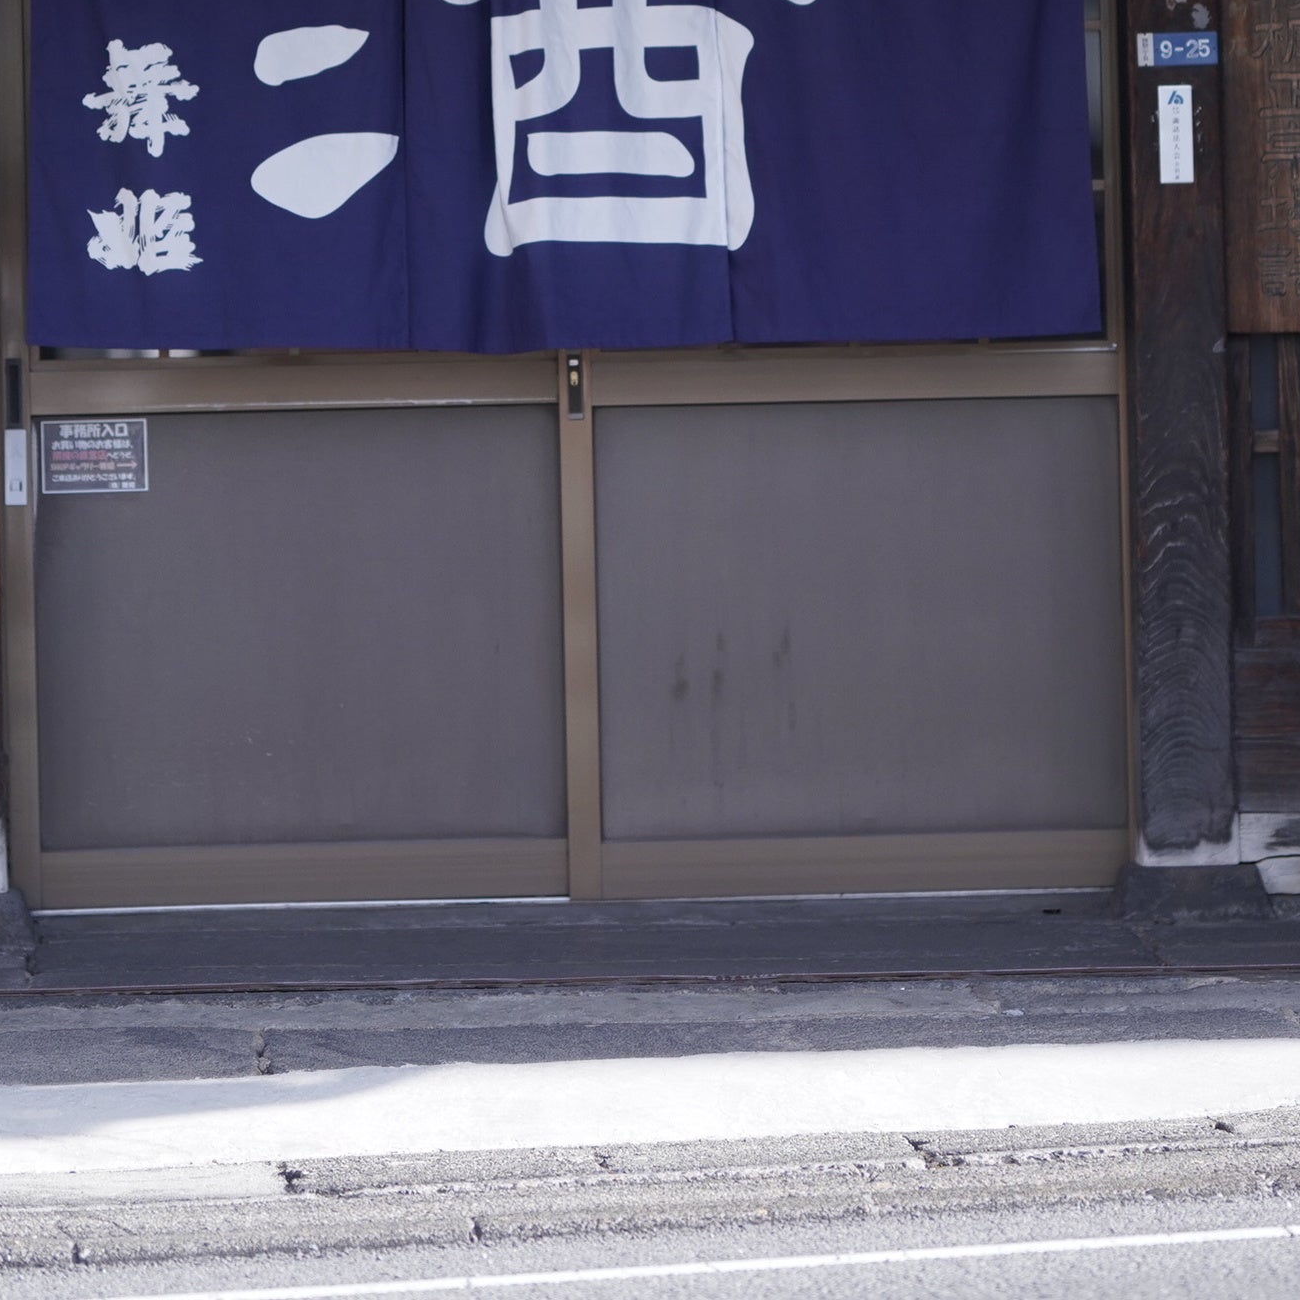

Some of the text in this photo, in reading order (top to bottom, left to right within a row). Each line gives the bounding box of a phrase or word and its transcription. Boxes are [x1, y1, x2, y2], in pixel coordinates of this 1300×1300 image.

[1160, 39, 1211, 59] 9-25
[81, 38, 204, 276] 舞姫
[58, 423, 129, 439] 事務所入口
